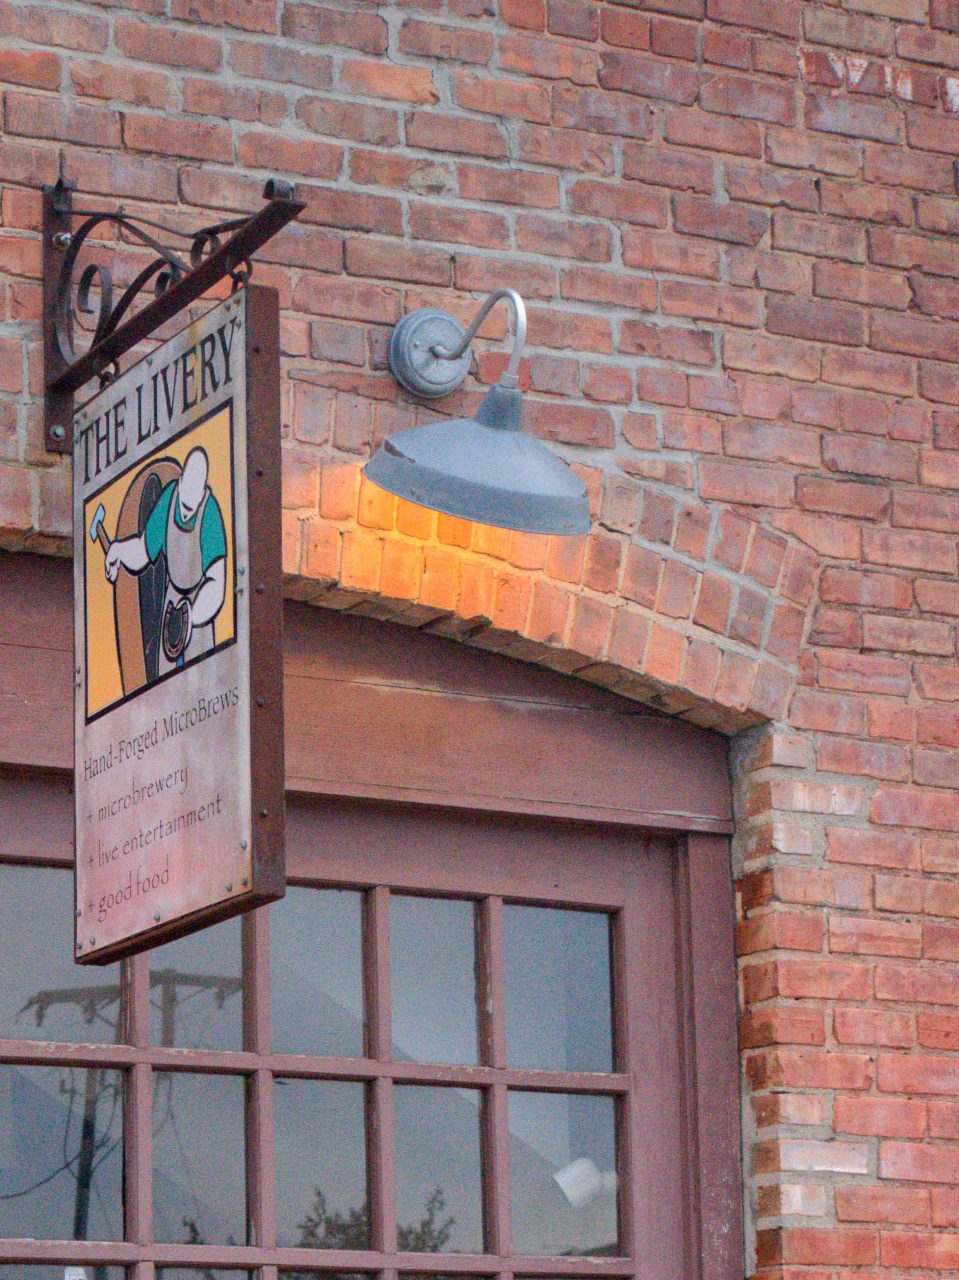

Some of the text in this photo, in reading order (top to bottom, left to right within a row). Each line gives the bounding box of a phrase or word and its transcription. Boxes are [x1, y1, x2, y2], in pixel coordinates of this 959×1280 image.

[79, 315, 239, 486] THE LIVERY
[83, 686, 240, 782] Hand-Forged MicroBrews
[97, 793, 223, 869] live entertainment
[98, 764, 189, 824] microbrewery
[97, 854, 171, 923] good food
